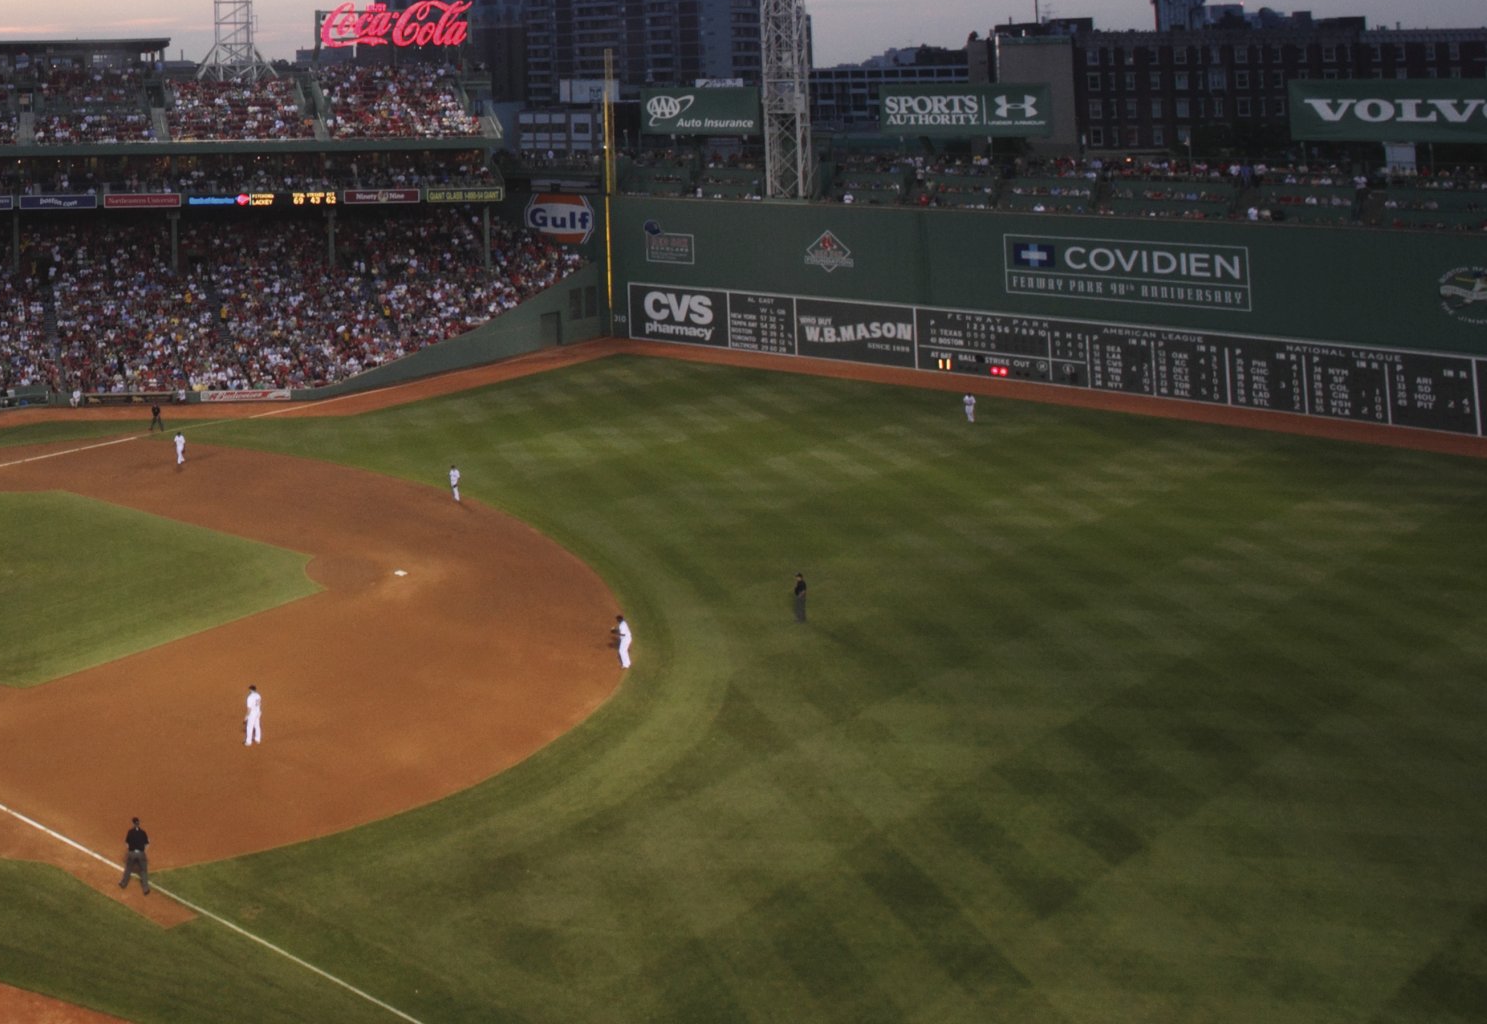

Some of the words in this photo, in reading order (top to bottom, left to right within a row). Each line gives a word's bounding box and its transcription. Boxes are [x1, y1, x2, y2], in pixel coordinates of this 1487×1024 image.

[321, 0, 472, 48] Coca-Cola
[885, 95, 978, 114] SPORTS
[1304, 98, 1487, 122] VOLV
[676, 118, 702, 128] Auto
[704, 118, 754, 128] Insurance
[887, 114, 978, 125] AUTHORITY
[147, 197, 178, 205] University
[293, 196, 304, 204] 69
[310, 196, 320, 204] 43
[326, 196, 336, 204] 62
[429, 192, 445, 200] GIANT
[530, 208, 590, 229] Gulf
[1065, 246, 1240, 279] COVIDIEN
[1013, 276, 1062, 291] FENWAY
[1069, 280, 1103, 293] PARK
[1142, 285, 1243, 304] ANNIVERSARY
[644, 291, 713, 325] CVS
[614, 314, 626, 323] 310
[948, 313, 1001, 323] FENWAY
[1013, 319, 1049, 328] PARK
[645, 321, 712, 341] pharmacy
[805, 322, 912, 343] W.B.MASON
[940, 329, 962, 337] TEXAS
[1103, 328, 1156, 338] AMERICAN
[1162, 332, 1203, 343] LEAGUE
[867, 342, 890, 351] SINCE
[938, 337, 964, 346] BOSTON
[958, 354, 976, 362] BALL
[985, 357, 1010, 366] STRIKE
[1013, 360, 1030, 368] OUT
[1286, 345, 1345, 357] NATIONAL
[1352, 352, 1402, 362] LEAGUE
